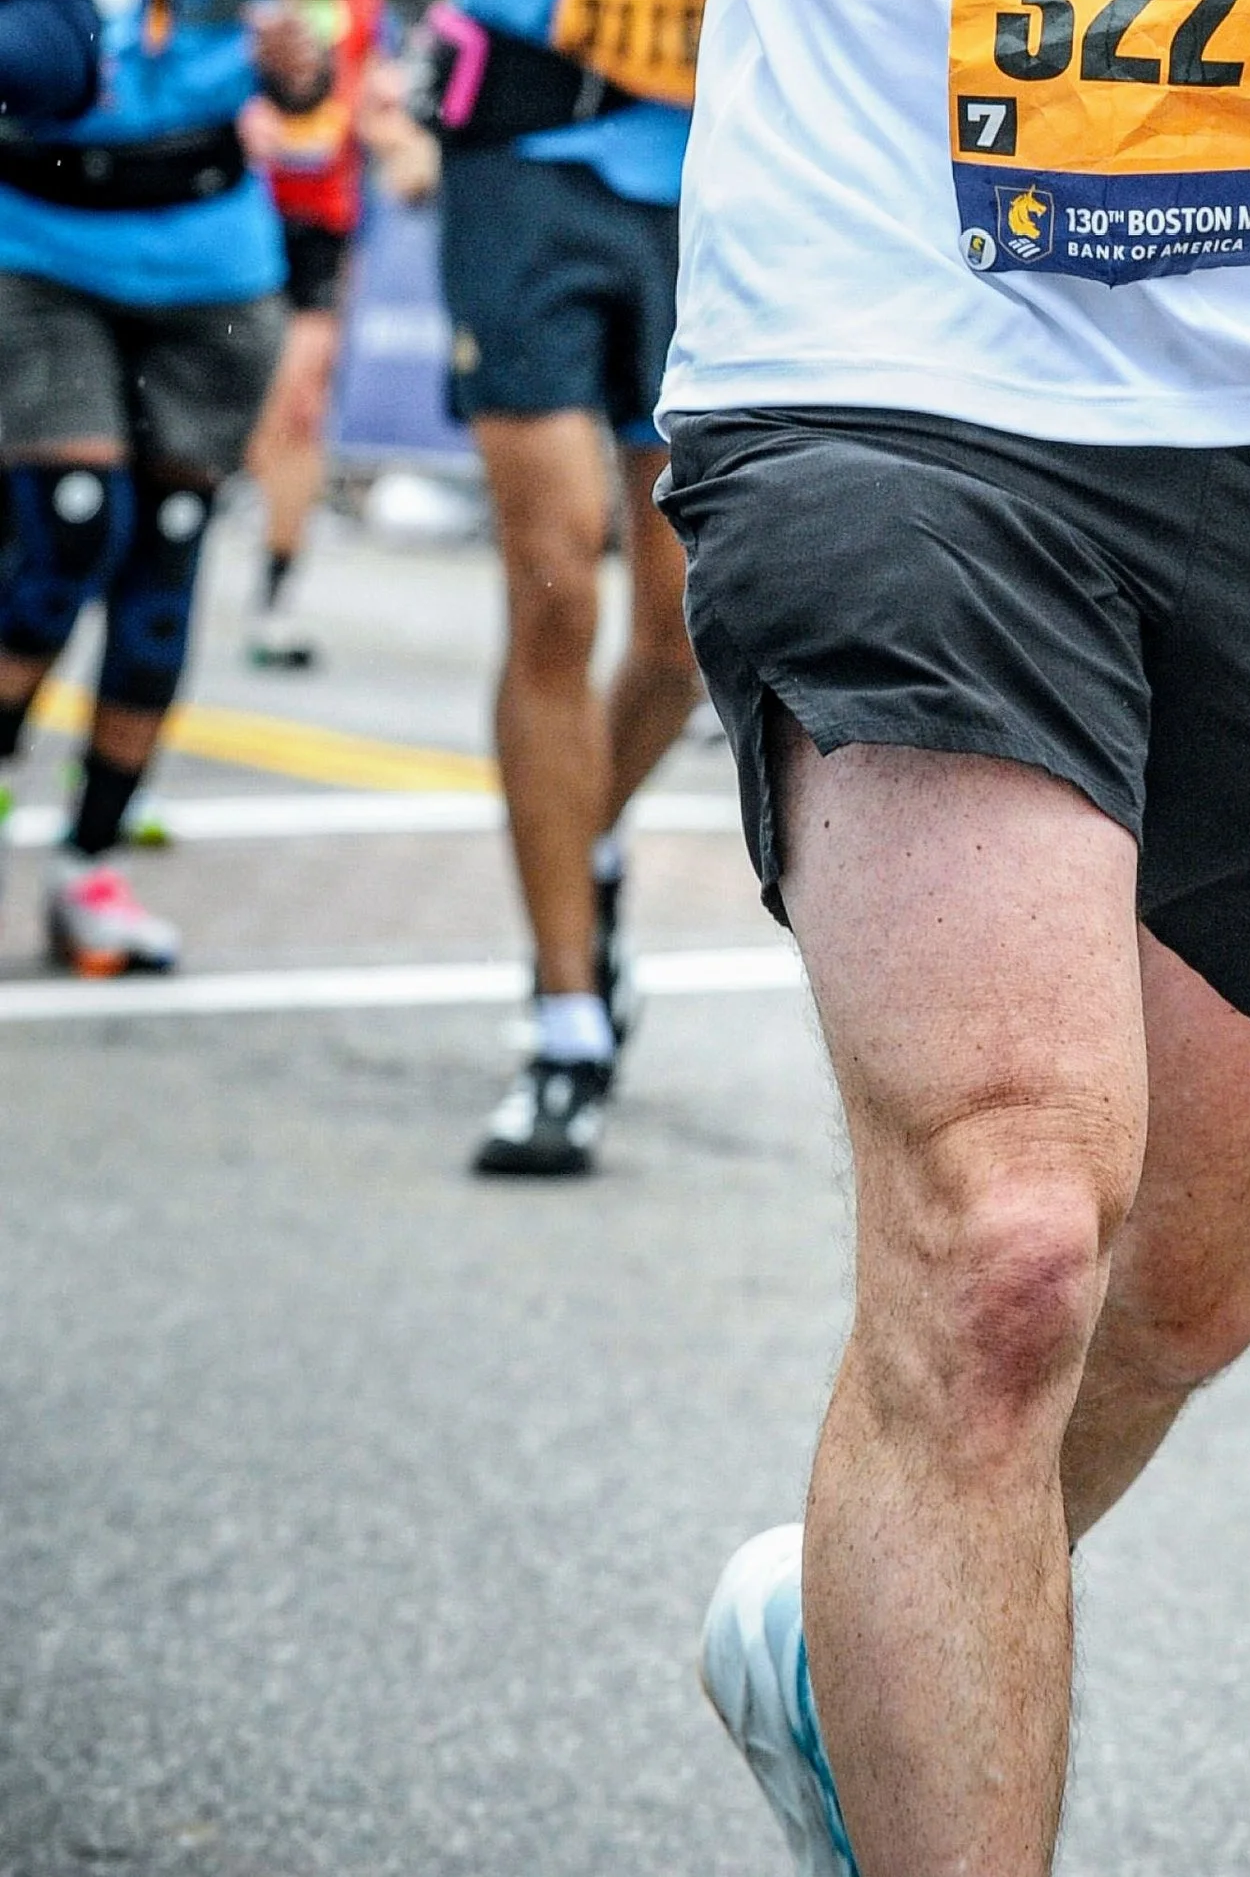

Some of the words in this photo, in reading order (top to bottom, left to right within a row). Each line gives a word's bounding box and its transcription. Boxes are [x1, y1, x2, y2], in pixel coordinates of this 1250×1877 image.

[967, 103, 1007, 147] 7
[1066, 207, 1125, 236] 130TH
[1128, 205, 1232, 236] BOSTON
[1067, 241, 1125, 261] BANK
[1131, 244, 1157, 260] OF
[1161, 238, 1244, 259] AMERICA
